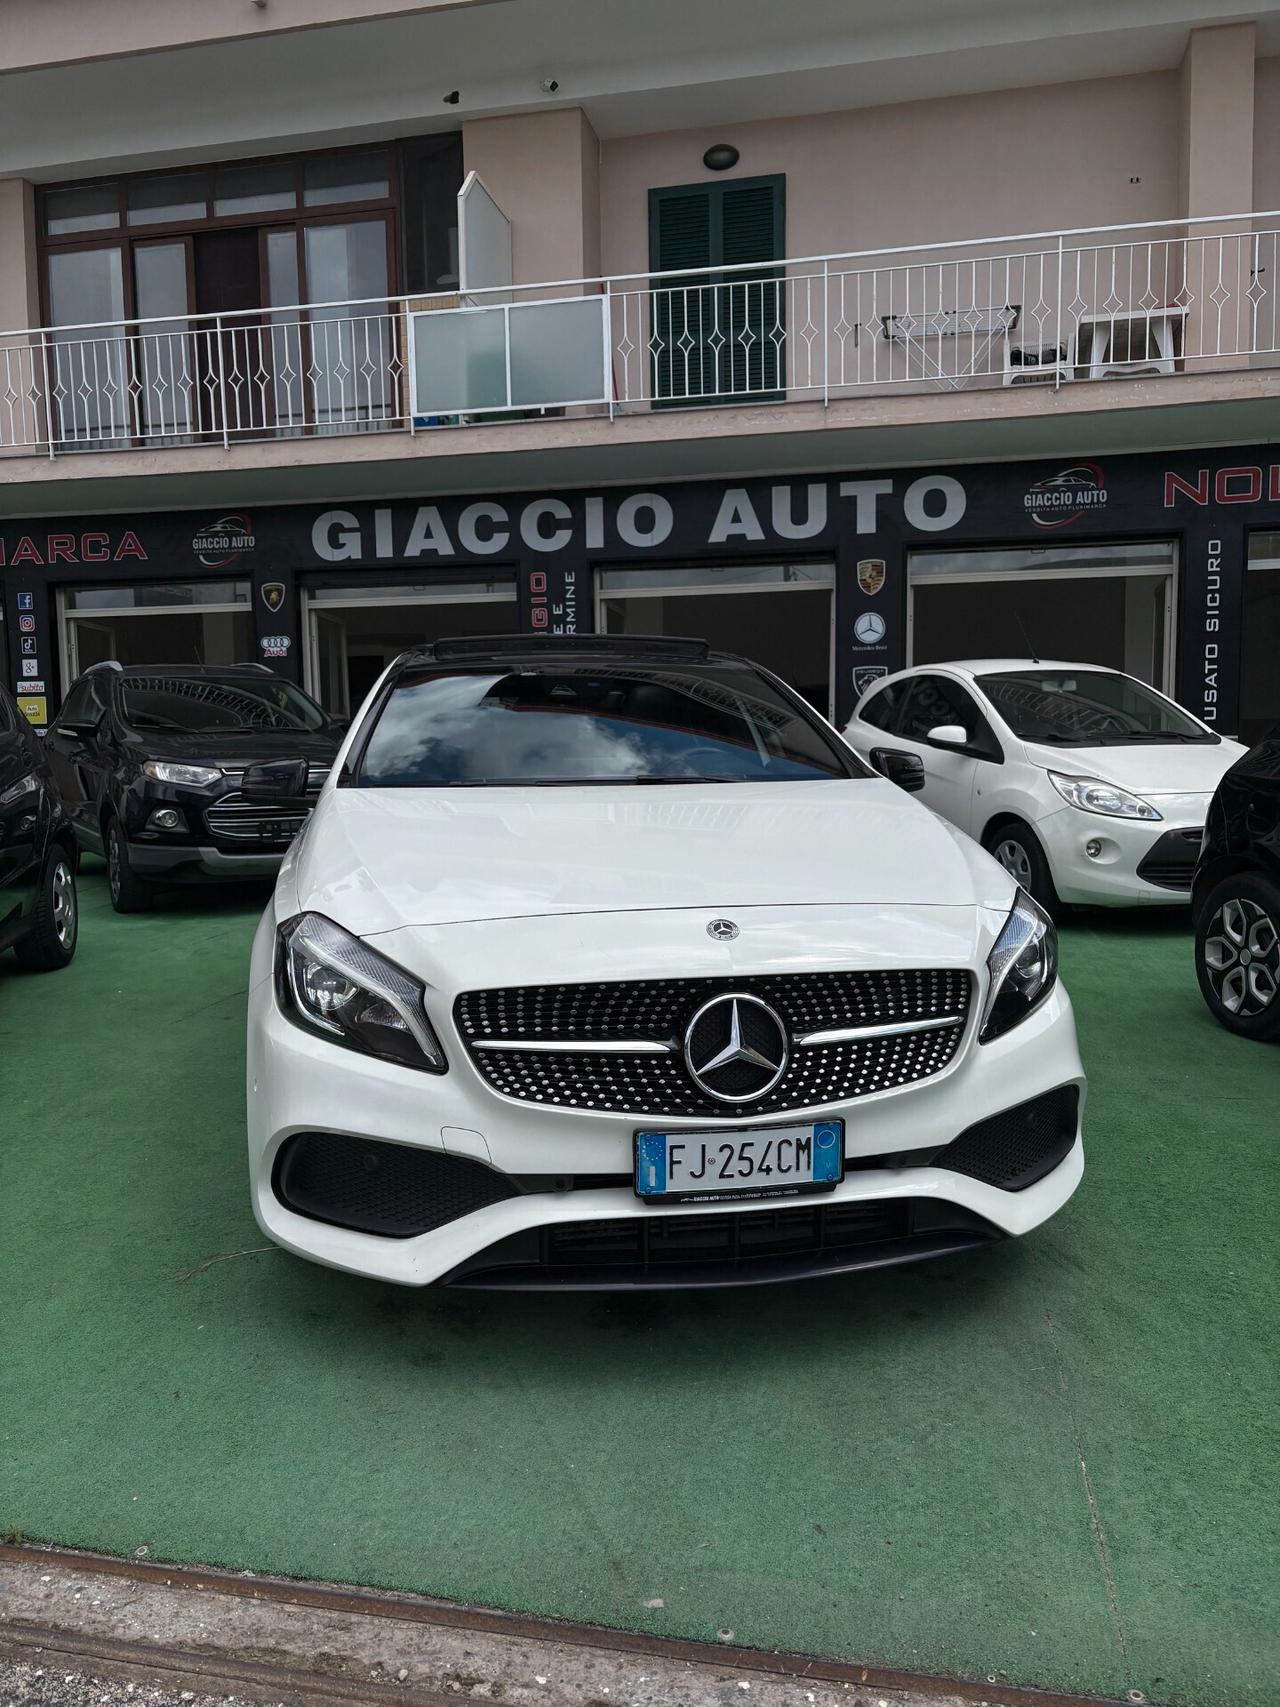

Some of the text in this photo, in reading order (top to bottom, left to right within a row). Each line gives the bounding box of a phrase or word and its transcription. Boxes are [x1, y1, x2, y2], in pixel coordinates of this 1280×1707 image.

[1024, 489, 1108, 507] GIACCIO AUTO
[311, 475, 967, 562] GIACCIO AUTO
[0, 531, 149, 566] ARCA
[192, 535, 256, 550] GIACCIO AUTO
[529, 571, 549, 634] GIO
[552, 603, 563, 615] E
[1204, 539, 1222, 721] USATO SICURO
[263, 648, 288, 657] Audi
